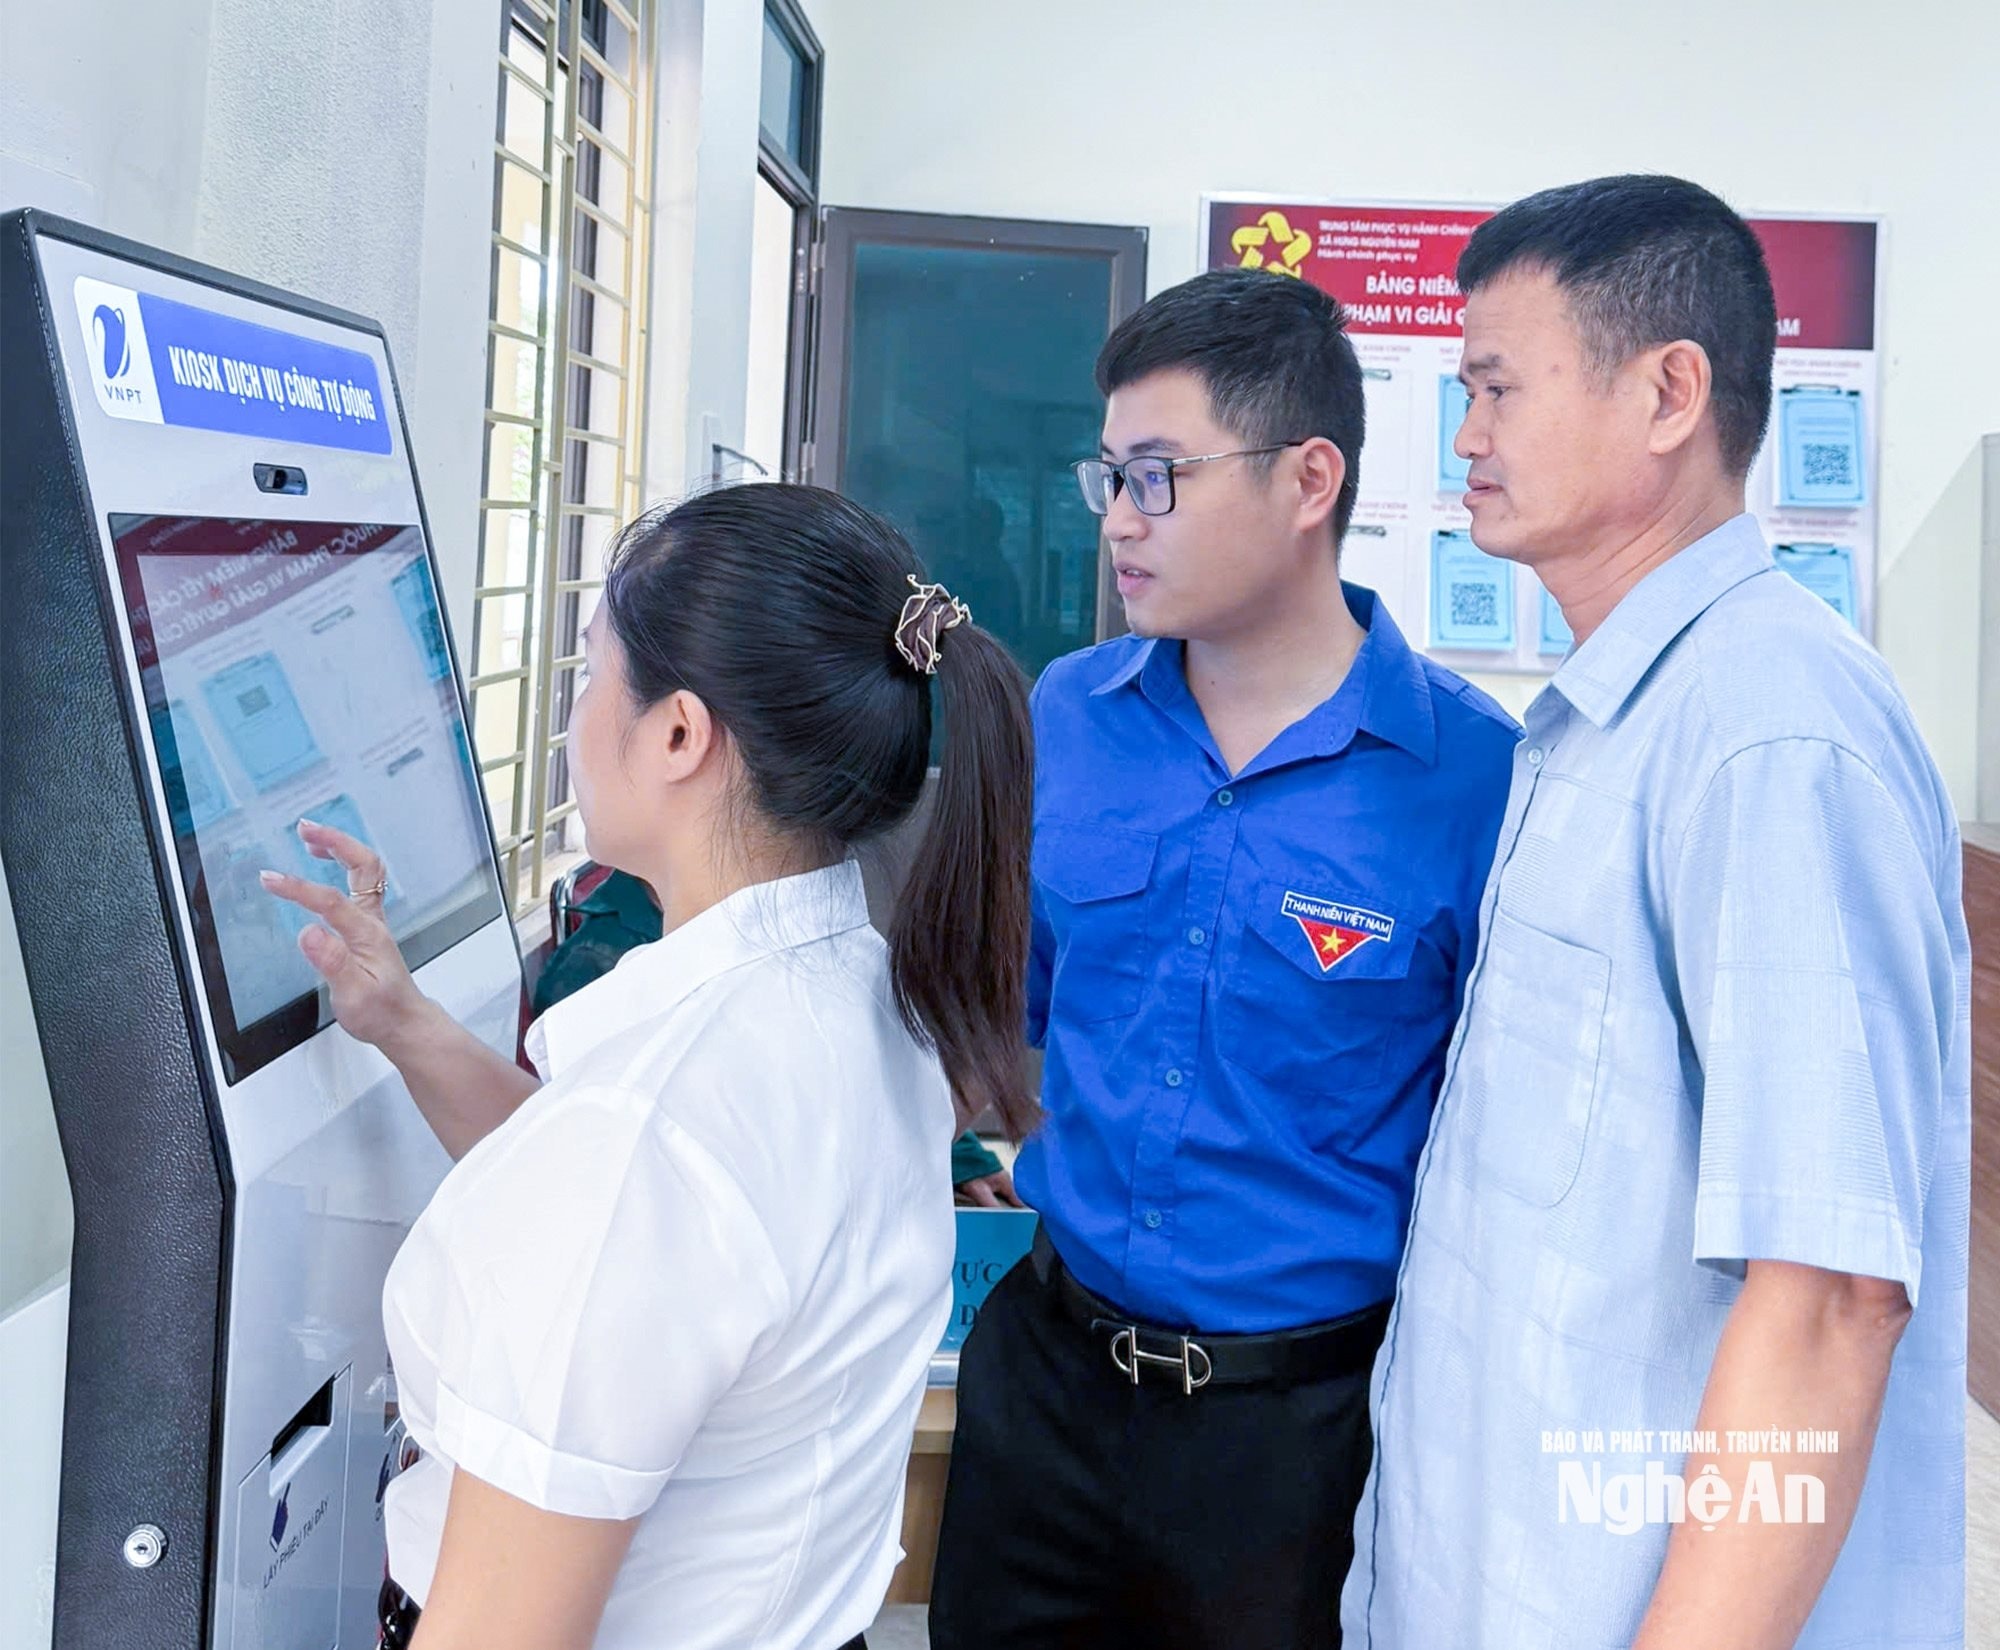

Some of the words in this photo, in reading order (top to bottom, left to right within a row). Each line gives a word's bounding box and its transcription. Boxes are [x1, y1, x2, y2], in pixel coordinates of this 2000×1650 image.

[1319, 220, 1349, 232] TRUNG
[1398, 237, 1420, 249] NAM
[1366, 269, 1416, 296] BẢNG
[1394, 305, 1412, 325] VI
[1415, 301, 1453, 325] GIẢI
[104, 384, 142, 404] VNPT
[168, 345, 224, 393] KIOSK
[223, 357, 264, 405] DỊCH
[261, 366, 285, 411] VỤ
[284, 366, 324, 412] CÔNG
[321, 379, 343, 422] TỰ
[340, 379, 377, 425] ĐỘNG
[1287, 898, 1321, 916] THANH
[1321, 905, 1342, 921] NIÊN
[1343, 911, 1365, 927] VIỆT
[1365, 918, 1389, 934] NAM
